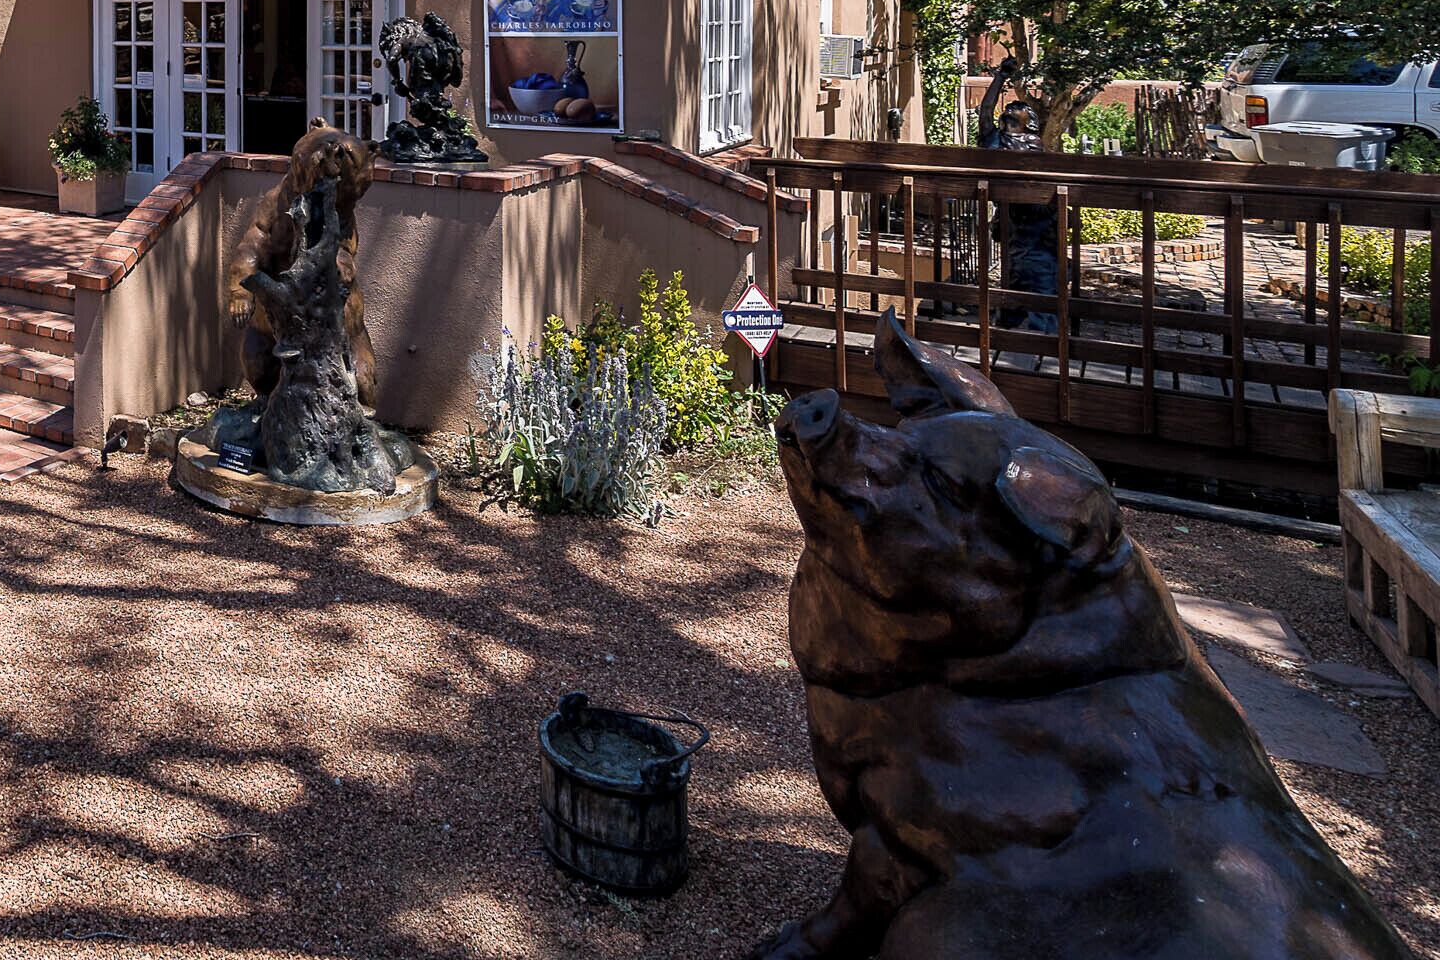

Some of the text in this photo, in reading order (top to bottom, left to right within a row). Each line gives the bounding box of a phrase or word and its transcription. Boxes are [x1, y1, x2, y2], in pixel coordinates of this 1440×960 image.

[490, 21, 540, 29] CHARLES
[493, 113, 561, 123] DAVID GRAY
[736, 313, 783, 326] Protection One
